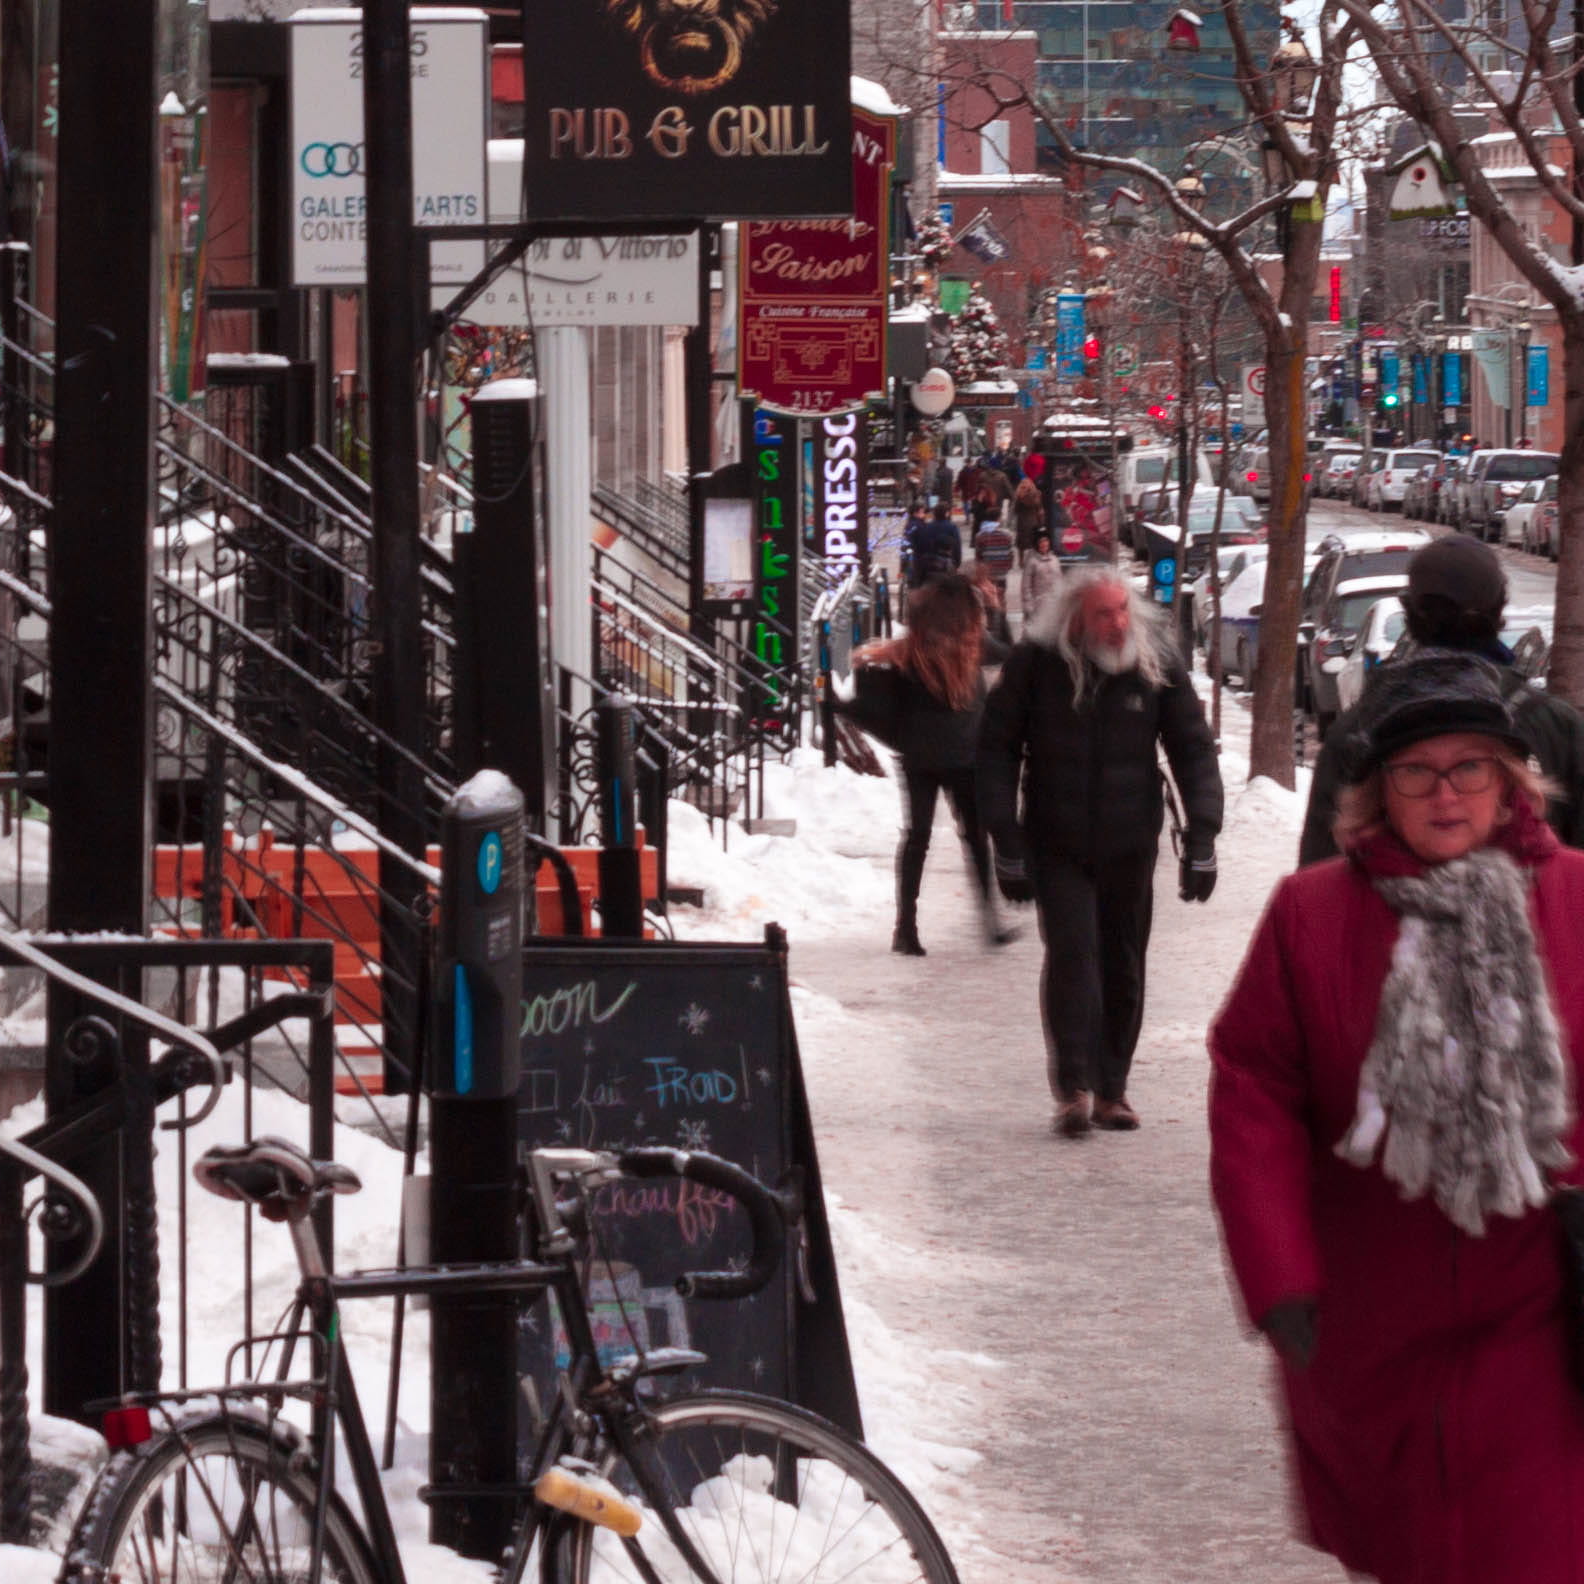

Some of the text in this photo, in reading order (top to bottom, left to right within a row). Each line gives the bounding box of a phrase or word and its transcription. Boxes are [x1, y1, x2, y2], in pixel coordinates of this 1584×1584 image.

[549, 106, 633, 160] PUB
[645, 105, 694, 158] &
[708, 104, 830, 156] GRILL
[751, 242, 873, 282] Saison
[791, 390, 835, 409] 2137
